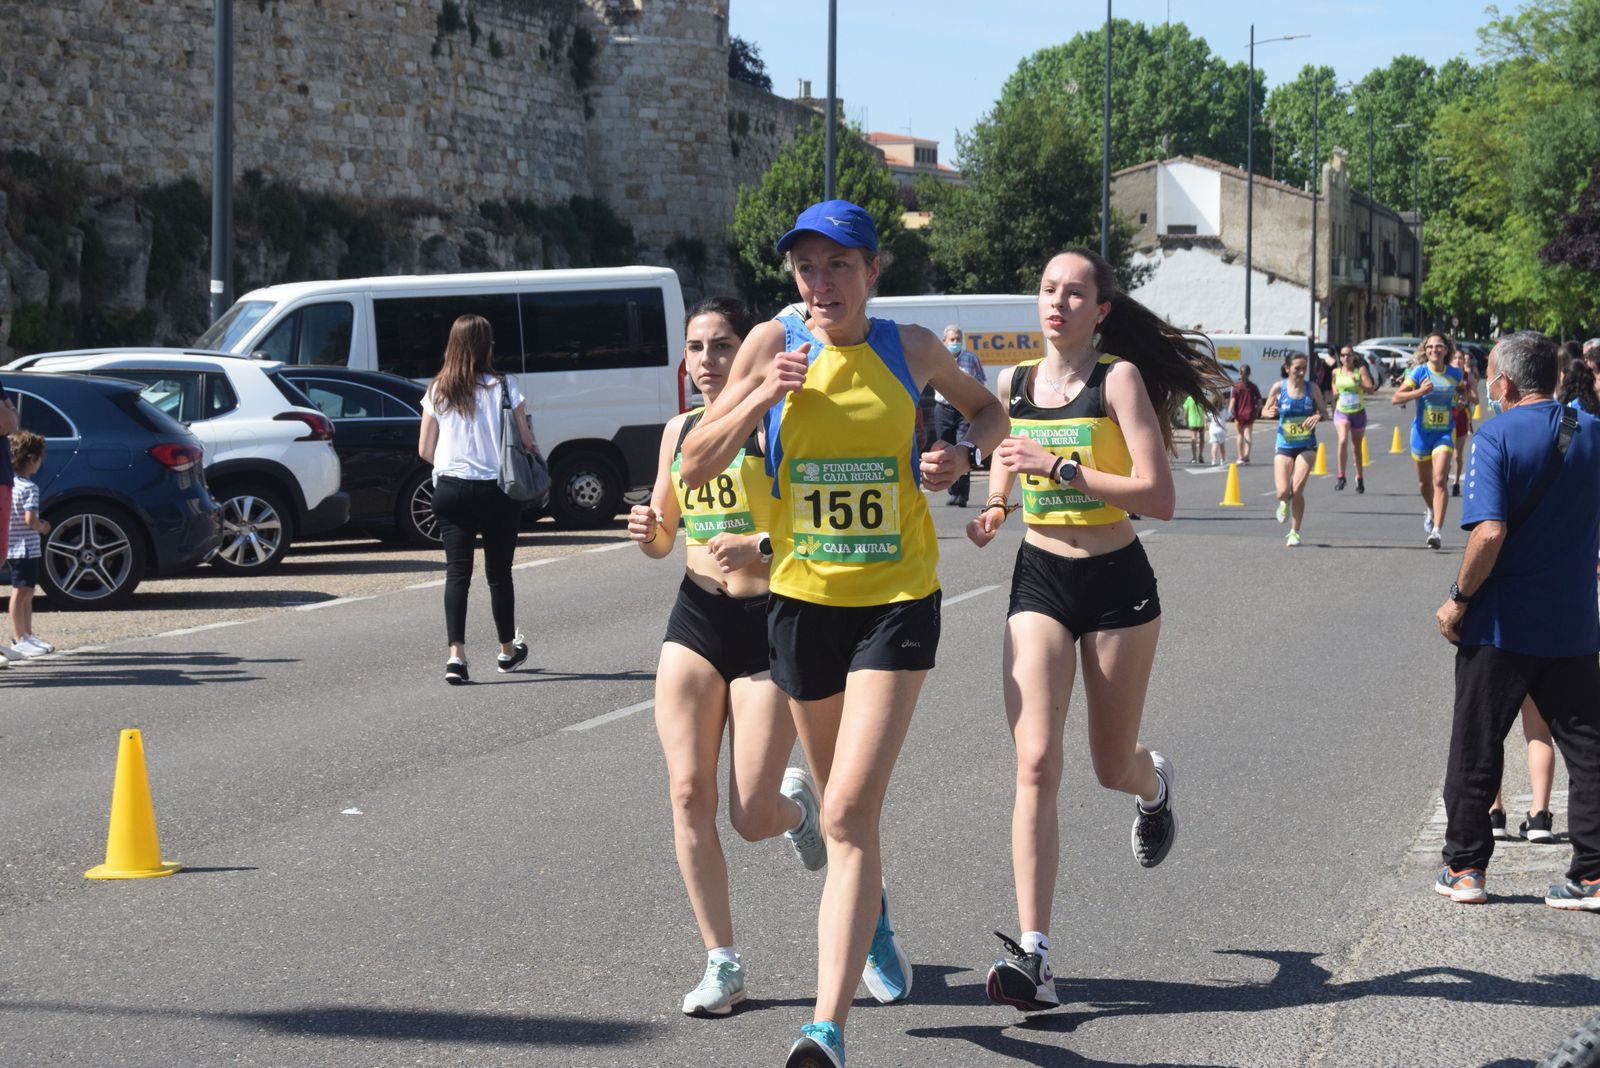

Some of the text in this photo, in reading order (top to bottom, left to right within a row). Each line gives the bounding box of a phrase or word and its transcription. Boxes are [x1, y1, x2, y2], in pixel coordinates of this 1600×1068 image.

[1263, 347, 1294, 358] Hert
[1429, 412, 1444, 423] 36
[1031, 428, 1079, 437] FUNDACION
[1051, 437, 1079, 445] RURAL
[823, 462, 885, 472] FUNDACION
[823, 473, 849, 482] CAJA
[851, 471, 885, 481] RURAL
[1038, 497, 1063, 506] CAJA
[804, 489, 883, 530] 156
[694, 518, 748, 531] CAJA RURAL
[823, 543, 851, 553] CAJA
